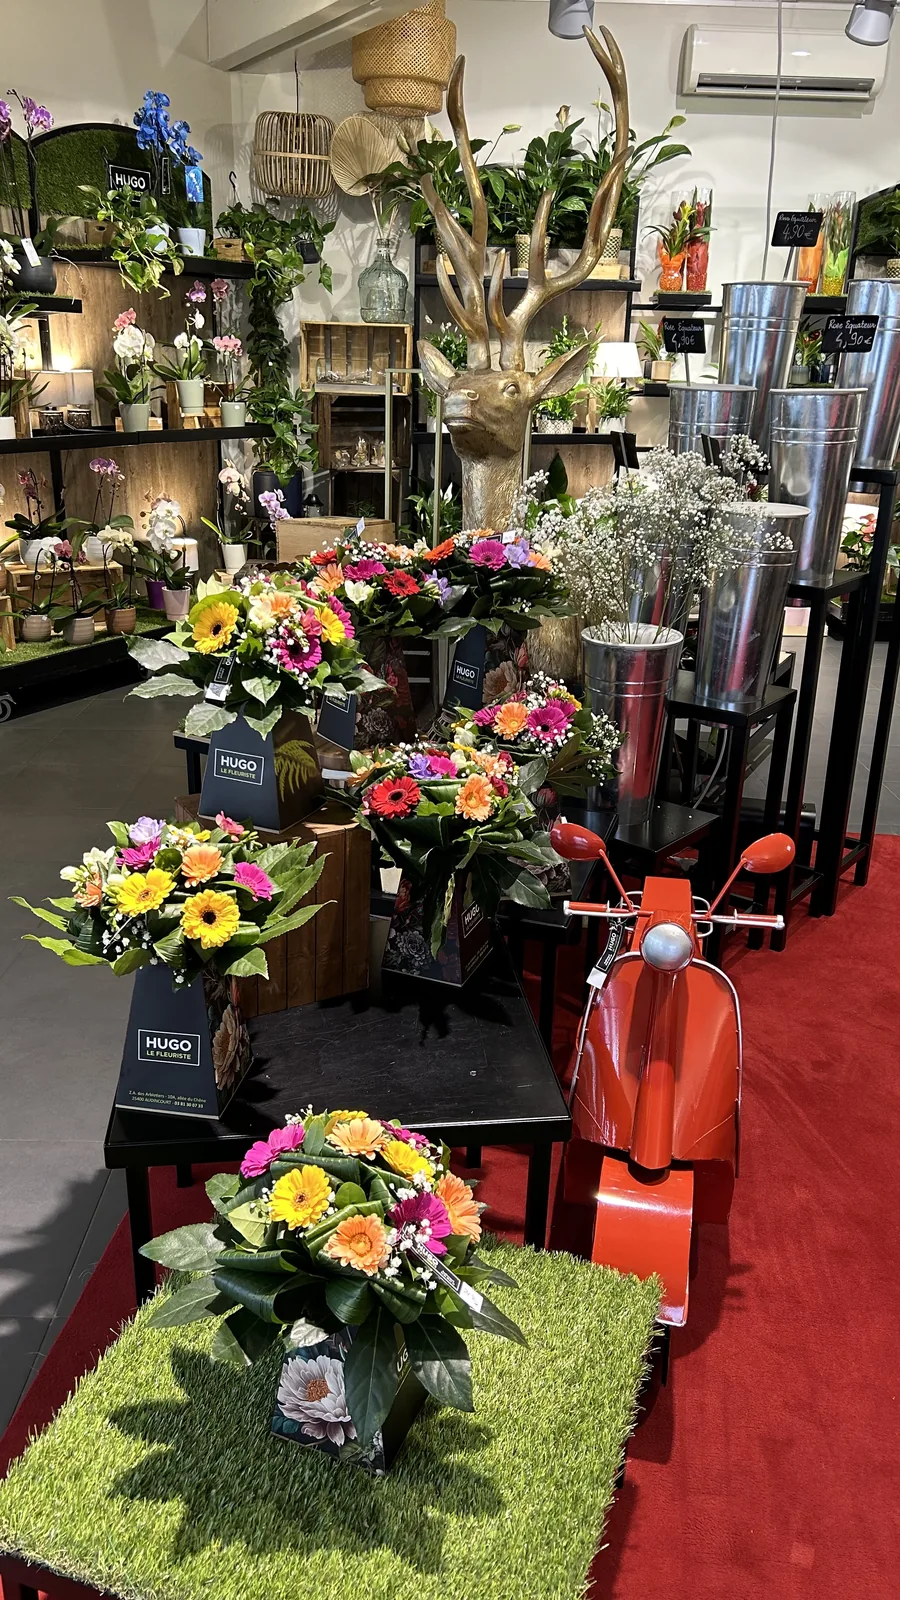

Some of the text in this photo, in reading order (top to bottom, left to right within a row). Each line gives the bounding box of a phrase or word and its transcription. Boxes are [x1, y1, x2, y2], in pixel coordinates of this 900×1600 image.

[115, 172, 146, 190] HUGO
[828, 319, 844, 330] Rose
[456, 665, 476, 679] HUGO
[220, 755, 258, 772] HUGO
[228, 769, 257, 779] FLEURISTE
[607, 932, 617, 952] HUGO
[146, 1036, 192, 1052] HUGO
[156, 1051, 192, 1060] FLEURISTE
